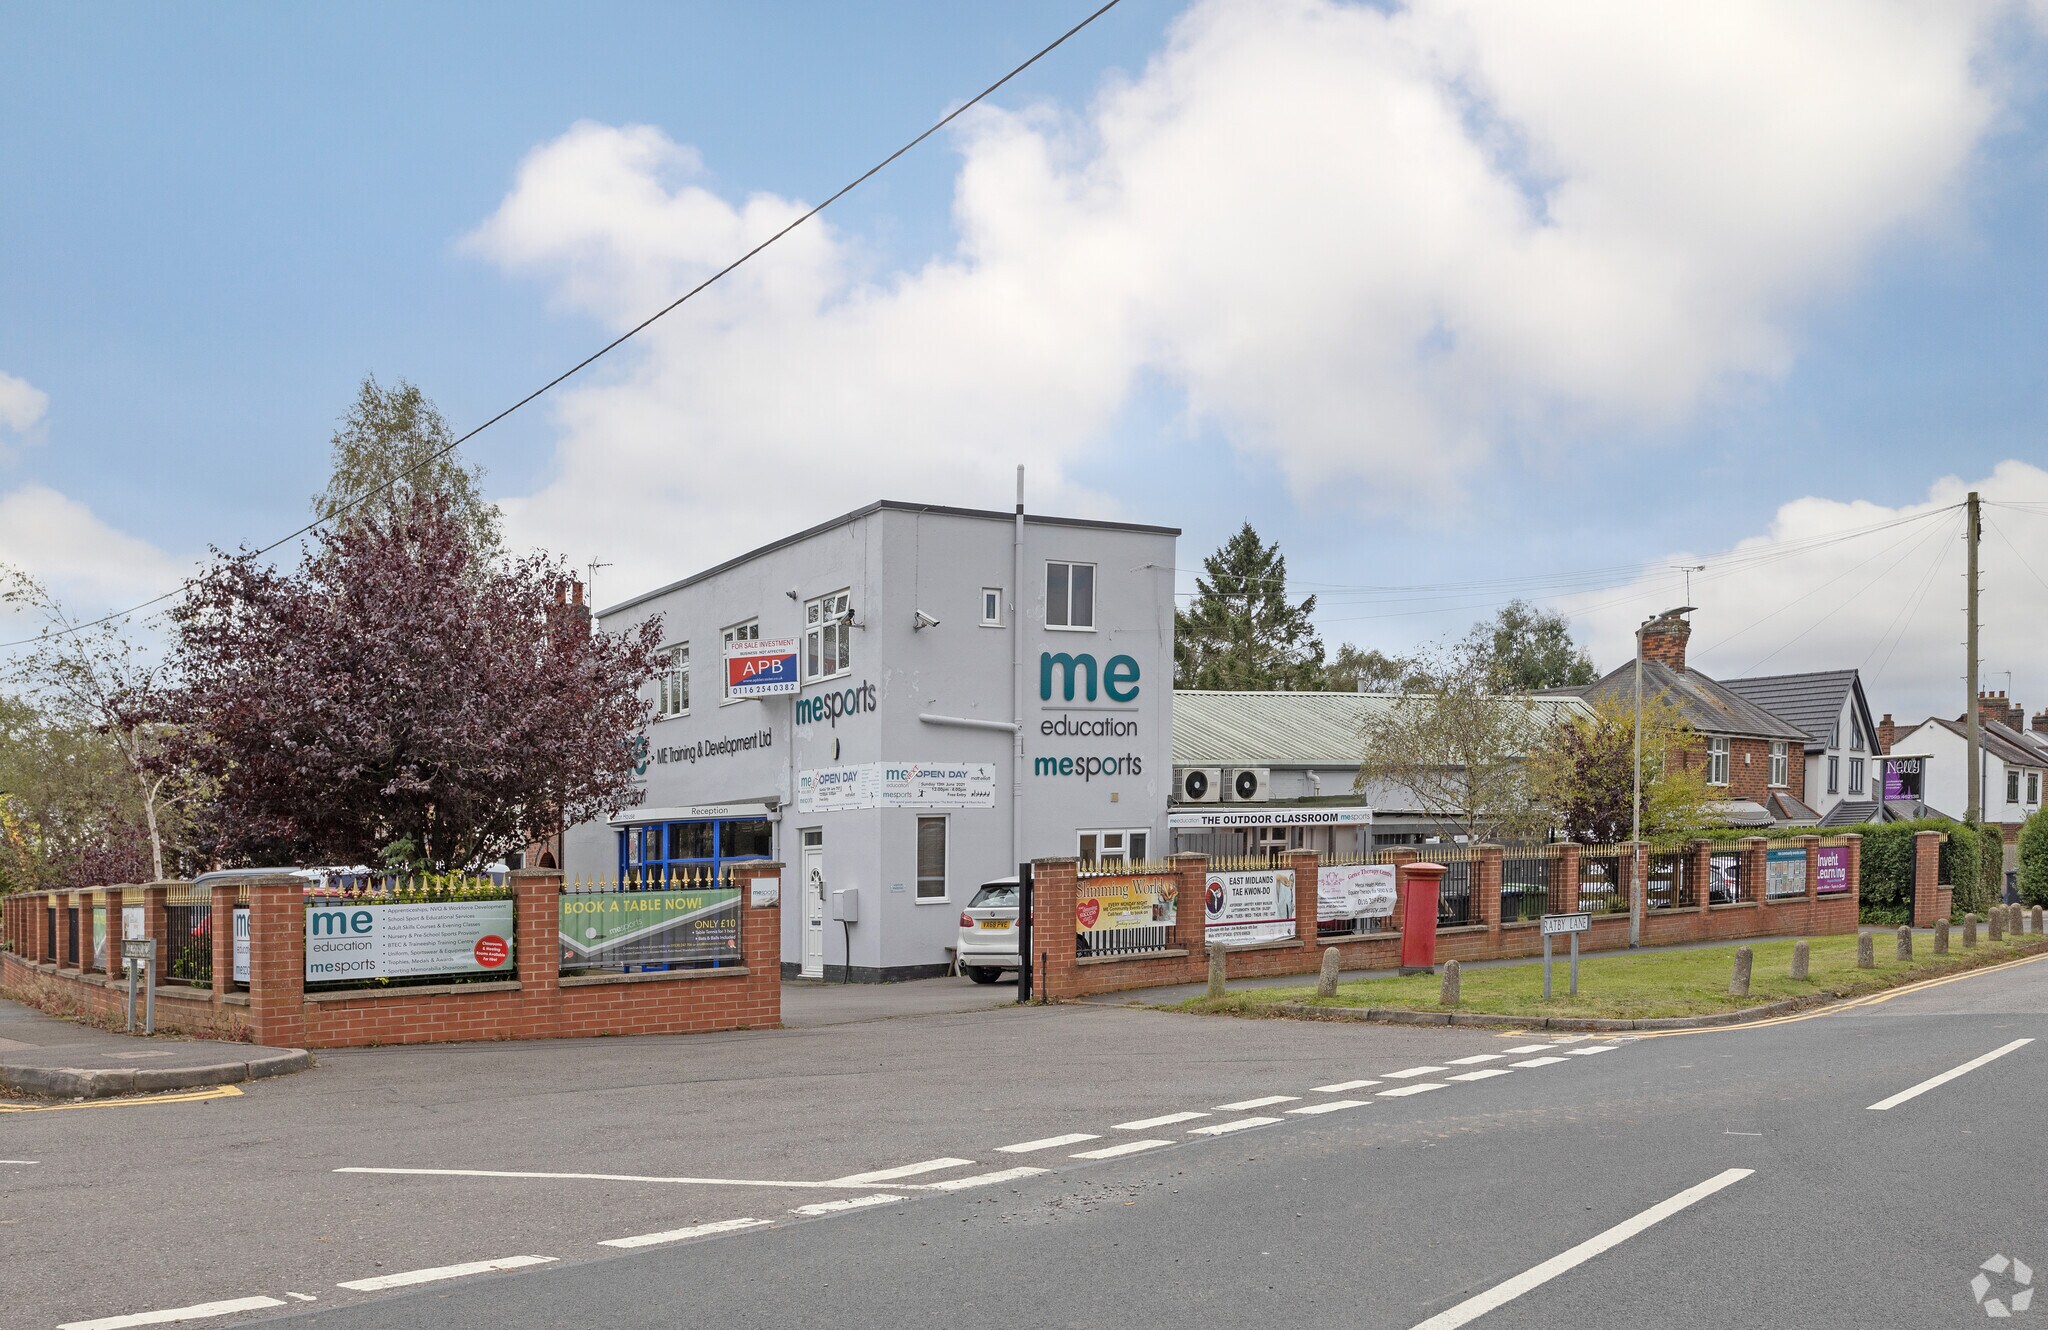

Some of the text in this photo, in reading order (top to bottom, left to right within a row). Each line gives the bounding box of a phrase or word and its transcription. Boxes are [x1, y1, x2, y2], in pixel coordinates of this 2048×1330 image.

[760, 640, 794, 648] INVESTMENT
[743, 660, 783, 676] APB
[1041, 652, 1140, 702] me
[796, 680, 877, 728] mesports
[1041, 714, 1137, 736] education
[657, 728, 772, 765] ME Training & Development Ltd
[1035, 753, 1141, 782] mesports
[1887, 760, 1920, 774] Nelly
[801, 771, 857, 787] me OPEN DAY
[886, 770, 908, 780] me
[692, 807, 728, 815] Reception
[1202, 816, 1220, 824] THE
[1224, 815, 1272, 824] OUTDOOR
[1275, 814, 1338, 823] CLASSROOM
[1341, 813, 1370, 822] mesports
[1818, 854, 1838, 867] Invent
[1229, 876, 1273, 885] EAST MIDLANDS
[1380, 870, 1392, 878] Centre
[1076, 877, 1163, 900] Slimming World
[1233, 887, 1271, 896] TAE KWON-DO
[564, 898, 702, 914] BOOK A TABLE NOW!
[313, 911, 373, 935] me
[609, 918, 643, 936] mesports
[695, 919, 736, 929] ONLY £10
[1544, 917, 1586, 931] RATBY LANE
[313, 941, 372, 952] education
[310, 959, 376, 974] mesports
